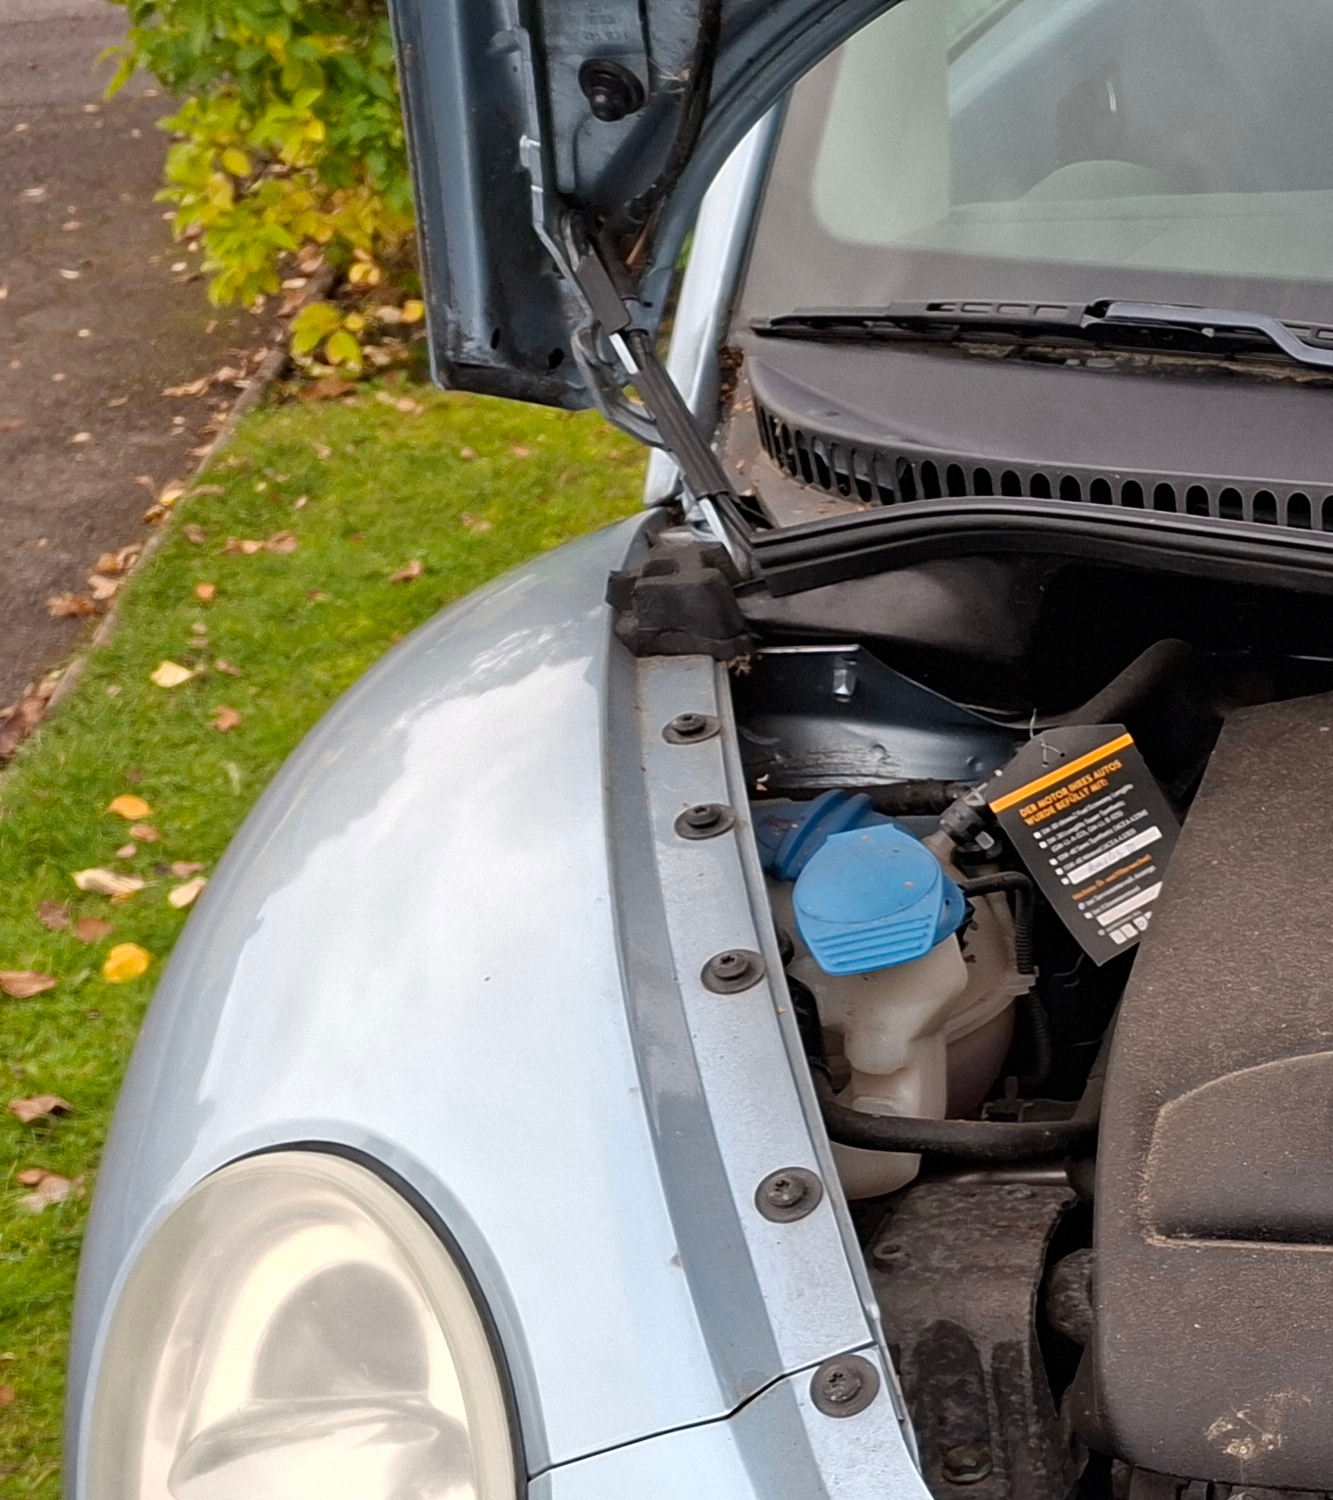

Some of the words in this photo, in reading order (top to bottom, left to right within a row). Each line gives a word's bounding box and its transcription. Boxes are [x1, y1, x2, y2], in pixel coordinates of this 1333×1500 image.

[1037, 787, 1069, 808] MOTOR
[1093, 759, 1122, 779] AUTOS
[1024, 806, 1056, 825] WURDE
